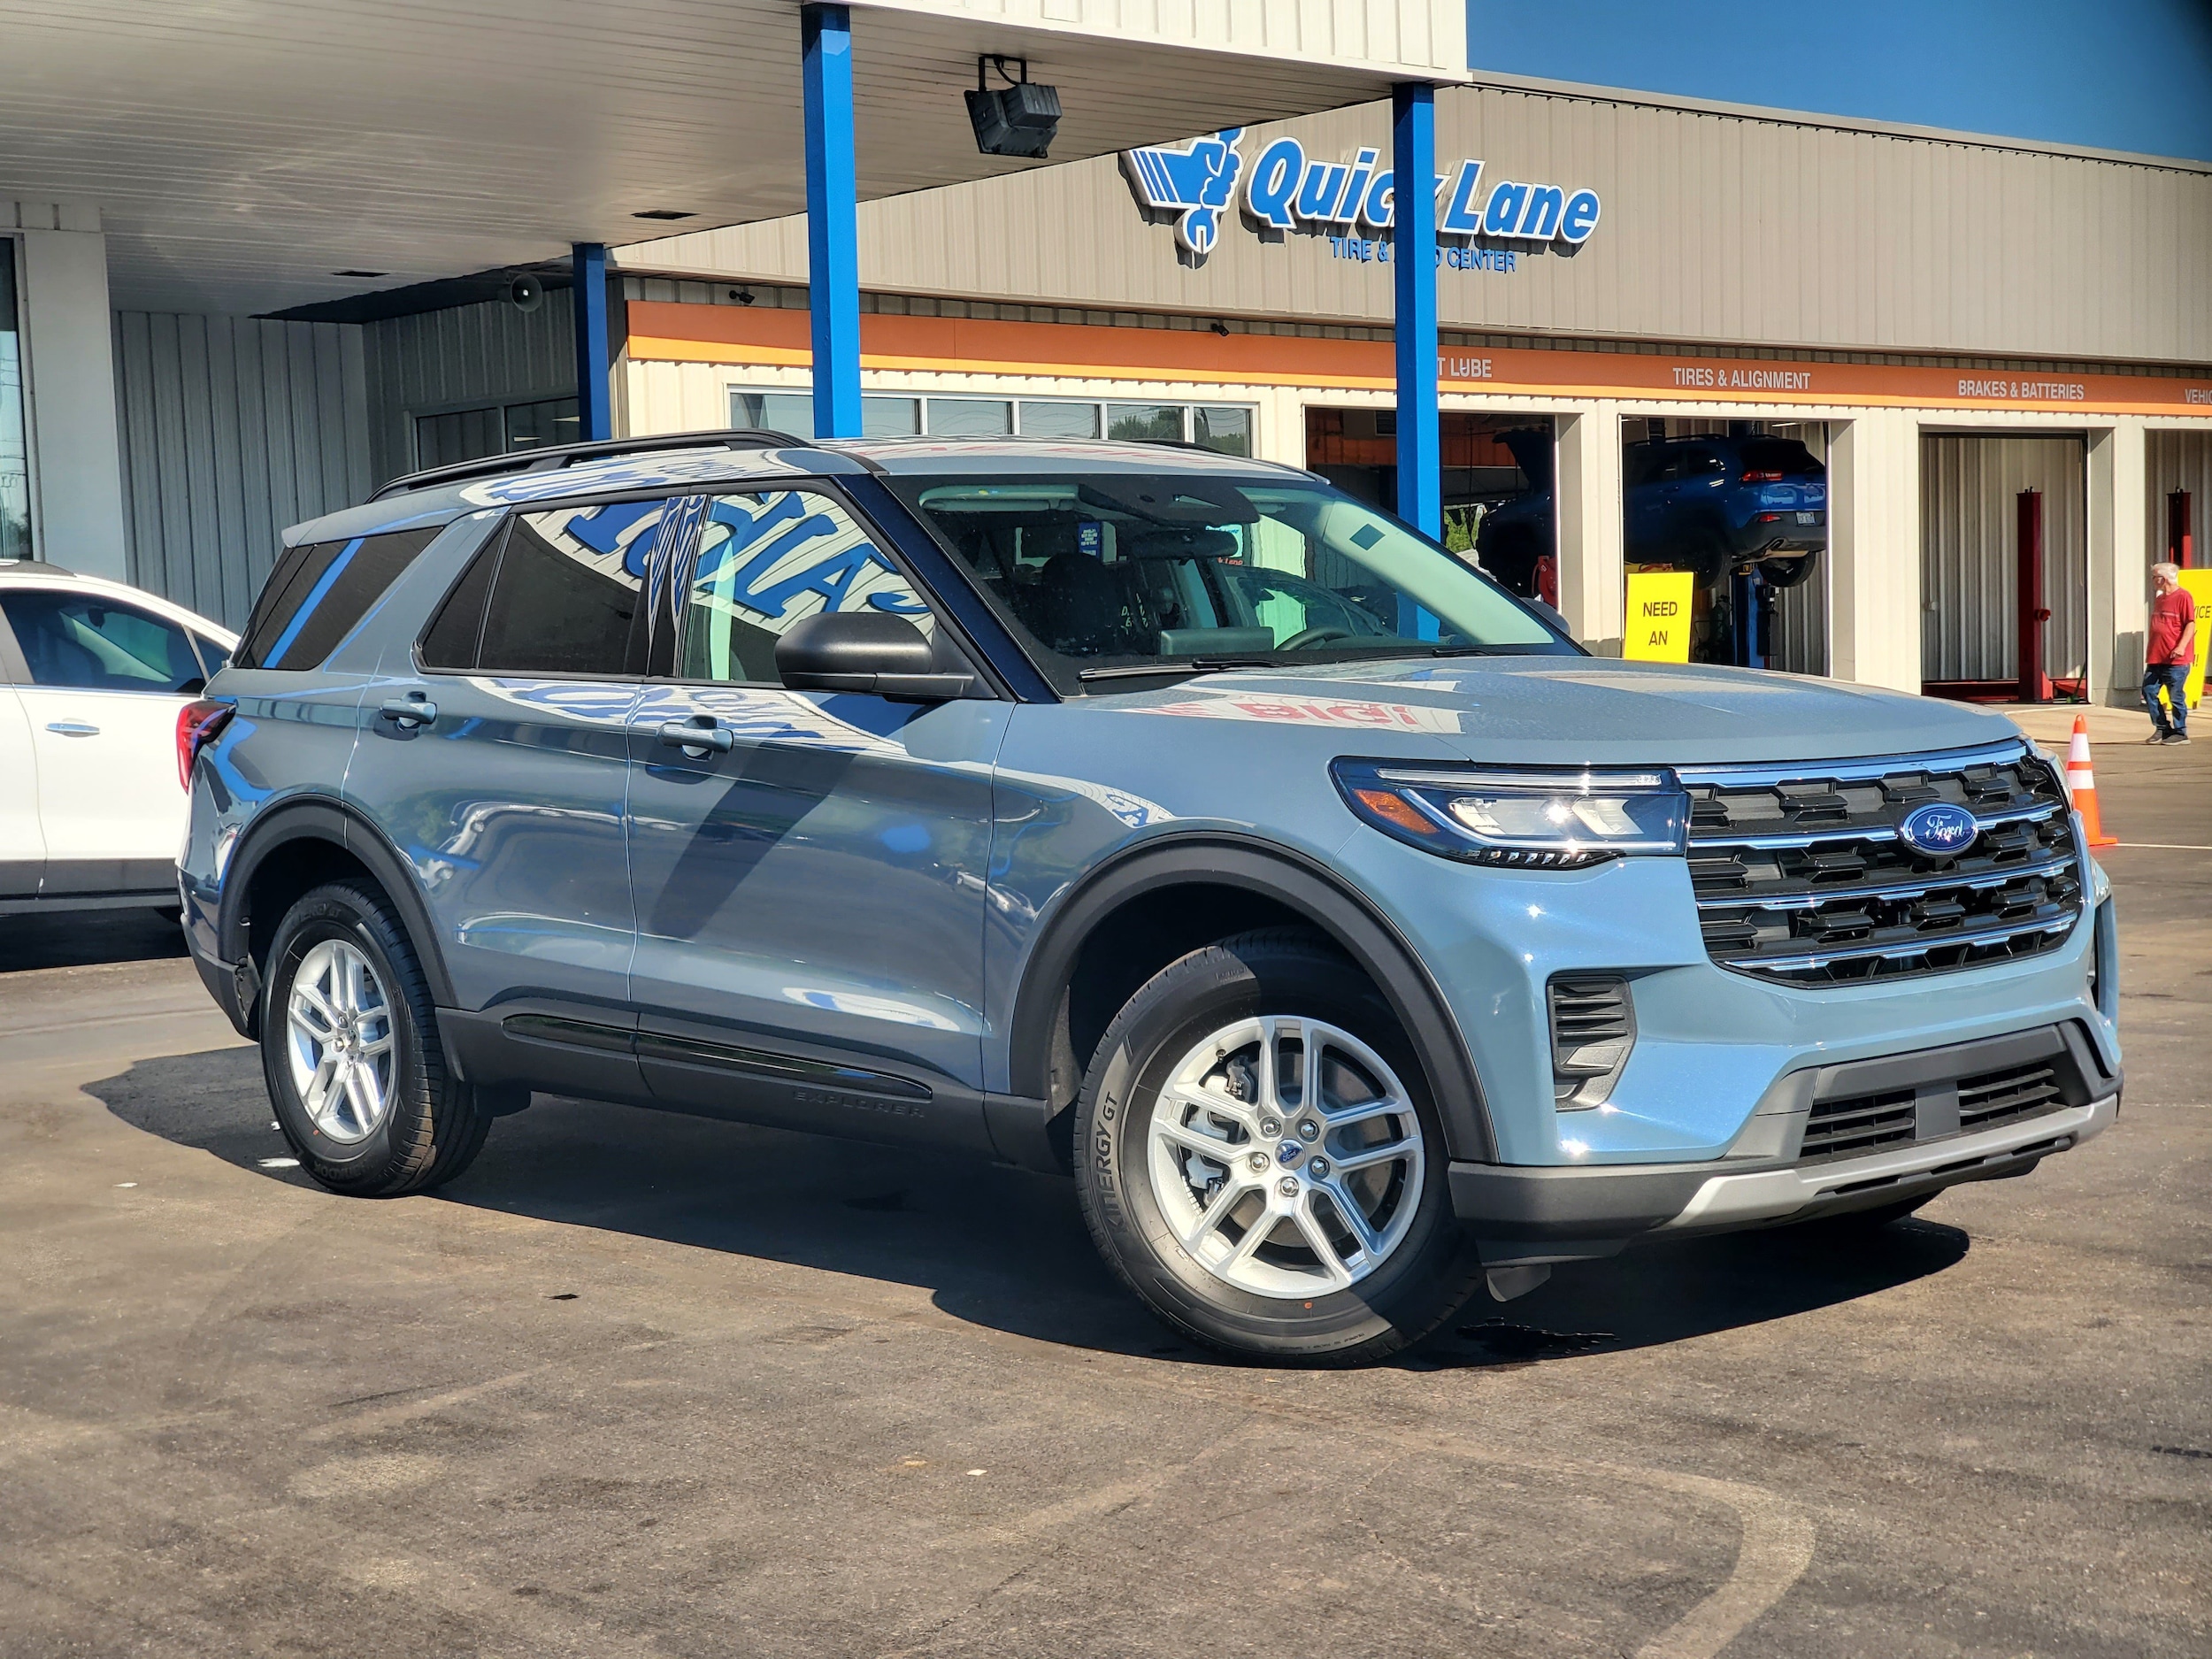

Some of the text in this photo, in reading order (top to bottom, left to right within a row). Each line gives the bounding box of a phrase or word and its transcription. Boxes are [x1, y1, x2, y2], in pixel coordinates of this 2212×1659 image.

[1248, 135, 1601, 244] Quic Lane
[1330, 236, 1372, 261] TIRE
[1378, 241, 1390, 262] &
[1448, 247, 1517, 273] CENTER
[1450, 357, 1493, 378] LUBE
[1672, 367, 1811, 390] TIRES & ALIGNMENT
[1958, 380, 2085, 400] BRAKES & BATTERIES
[1643, 601, 1678, 618] NEED
[1648, 630, 1669, 646] AN
[1925, 814, 1966, 841] Ford
[795, 1091, 926, 1118] EXPLORER
[1102, 1091, 1118, 1121] GT
